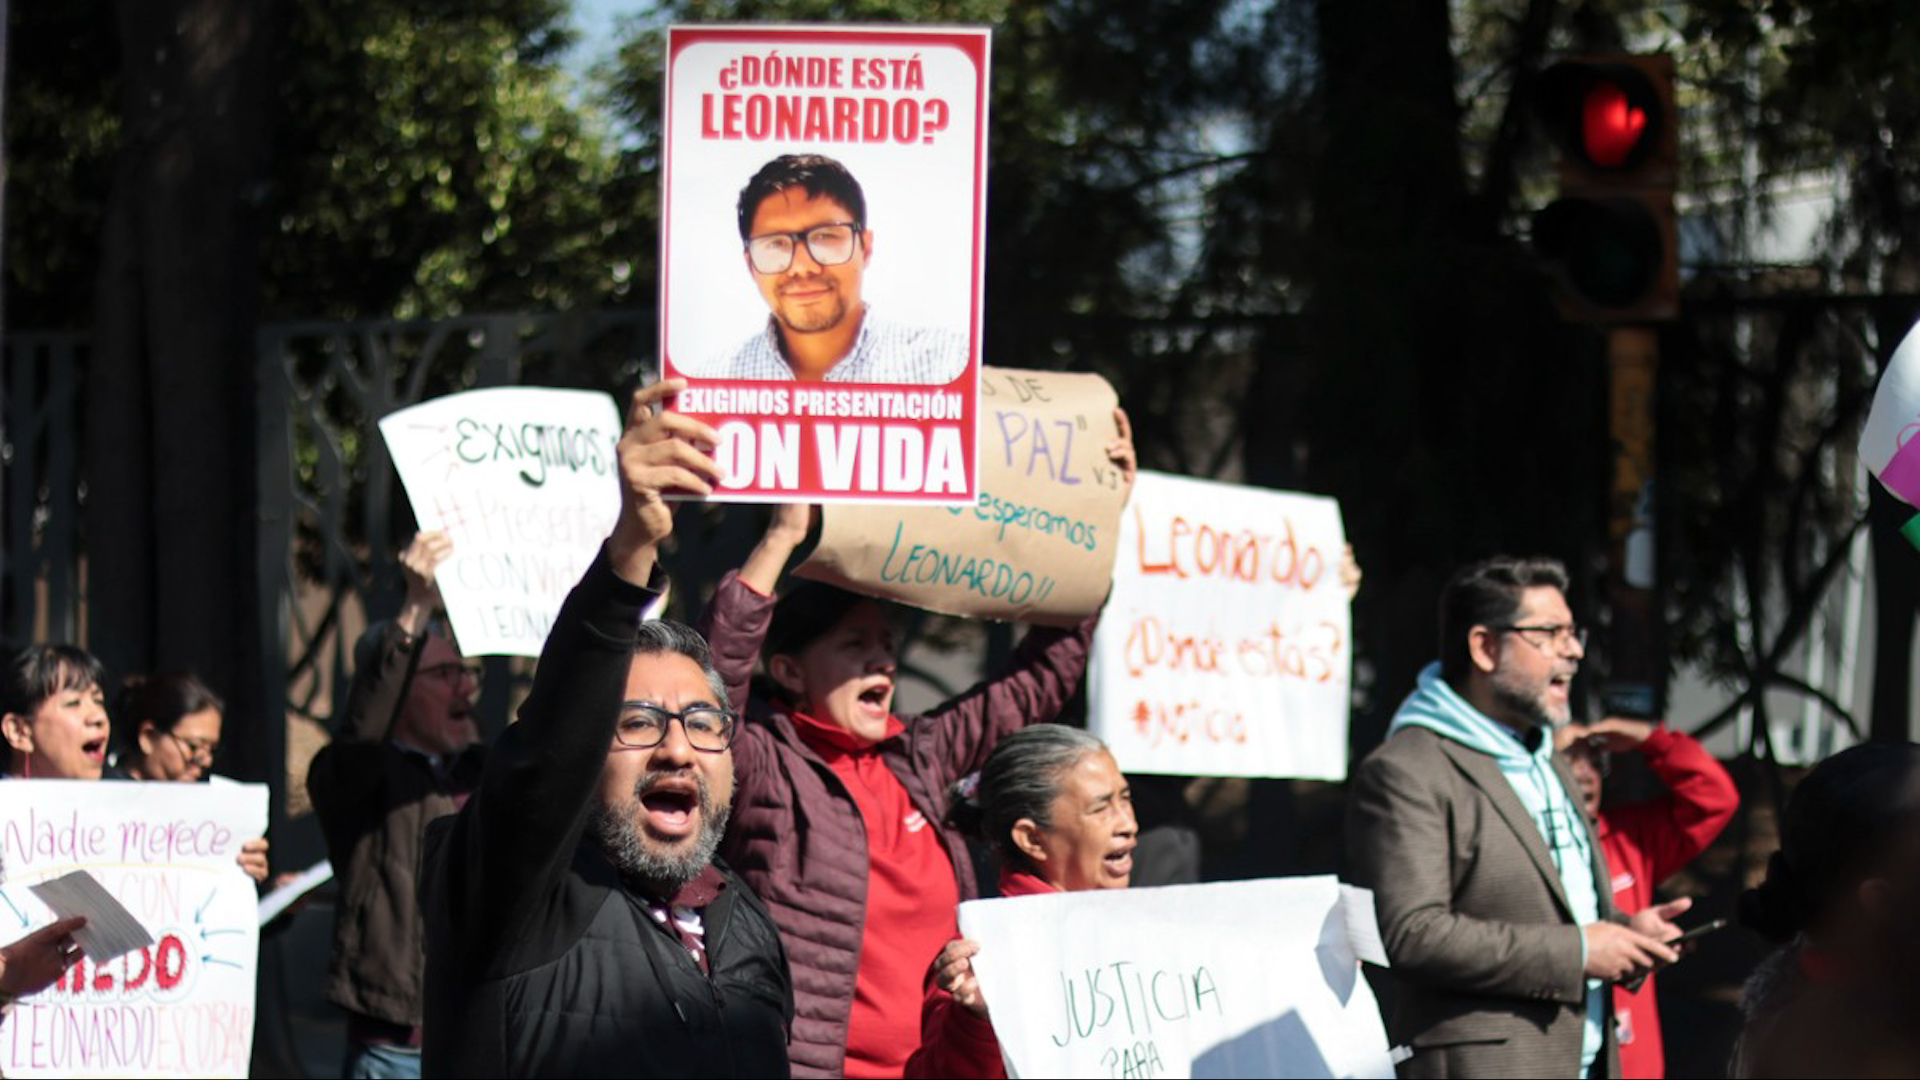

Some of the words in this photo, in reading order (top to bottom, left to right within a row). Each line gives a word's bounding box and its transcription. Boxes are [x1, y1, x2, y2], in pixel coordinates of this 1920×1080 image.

[719, 51, 843, 90] ¿DÓNDE
[852, 54, 924, 91] ESTÁ
[701, 93, 949, 145] LEONARDO?
[678, 388, 789, 416] EXIGIMOS
[794, 389, 963, 420] PRESENTACIÓN
[1005, 374, 1052, 403] DE
[713, 420, 800, 490] ON
[815, 422, 967, 494] VIDA
[974, 493, 1097, 551] esperamos
[1134, 503, 1326, 591] Leonardo
[5, 807, 106, 865] Nadie
[118, 819, 231, 864] merece
[1052, 961, 1223, 1048] JUSTICIA
[11, 1004, 155, 1071] LEONARDO
